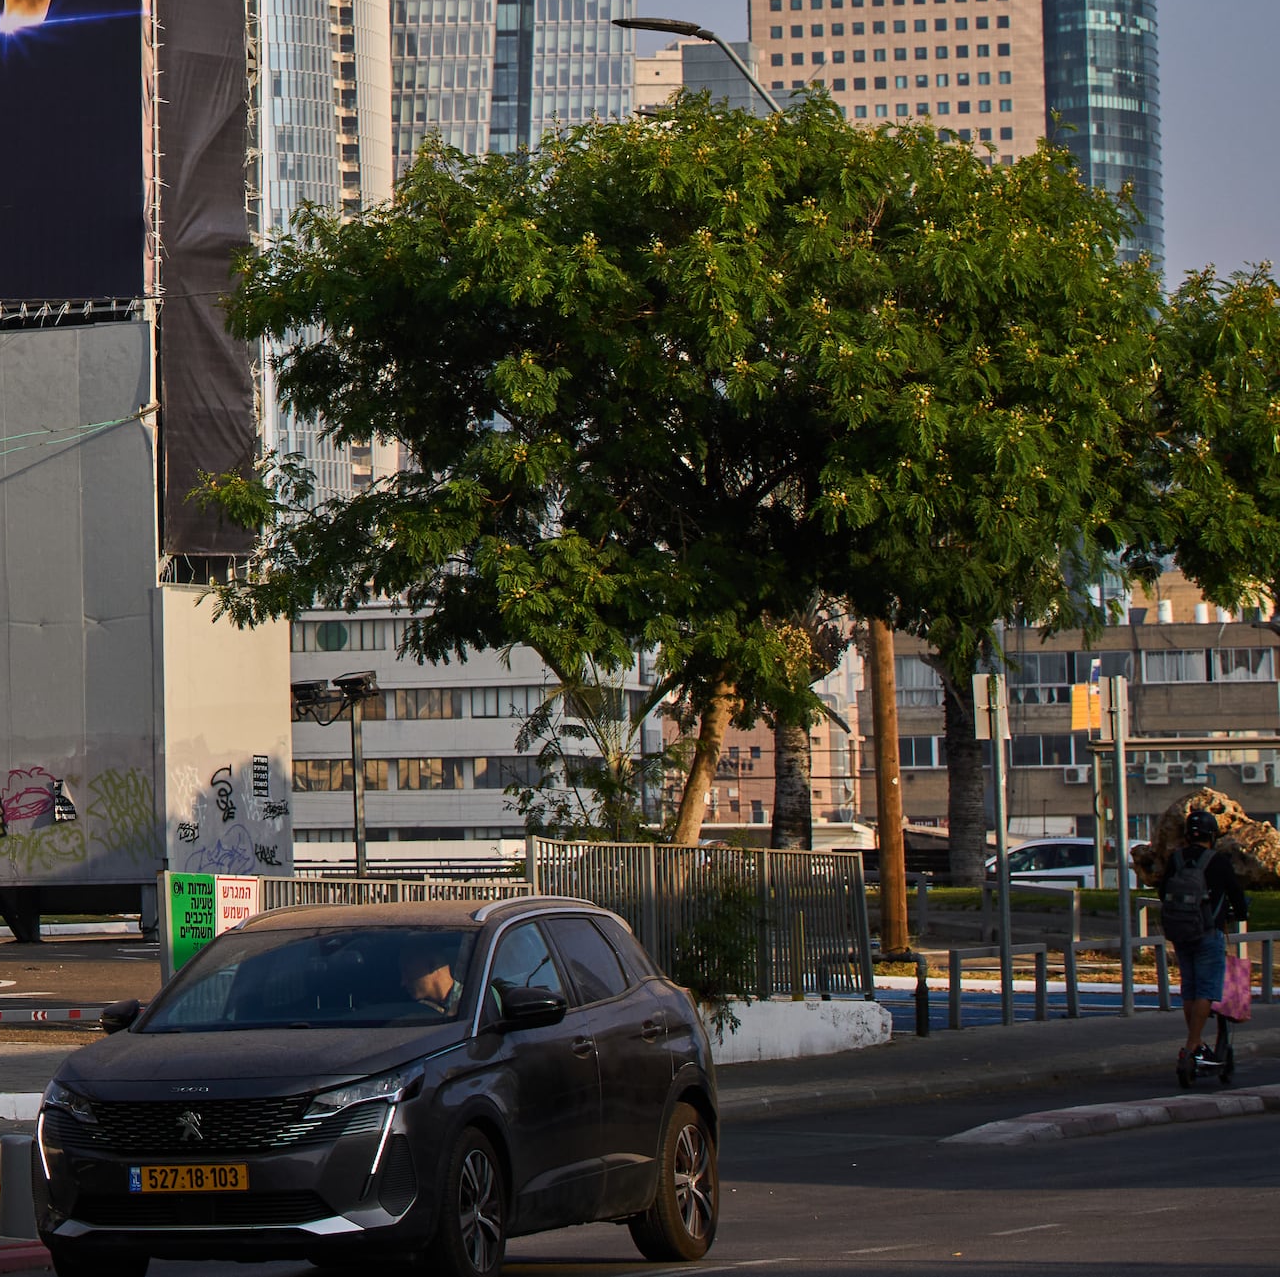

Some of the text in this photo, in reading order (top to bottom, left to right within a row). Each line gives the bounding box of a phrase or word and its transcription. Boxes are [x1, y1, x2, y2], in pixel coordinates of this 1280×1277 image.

[187, 882, 213, 895] עמדות
[222, 885, 251, 899] המגרש
[191, 897, 213, 910] טעינה
[185, 910, 213, 924] לרכבים
[223, 905, 250, 919] משמש
[180, 924, 213, 939] חשמליים
